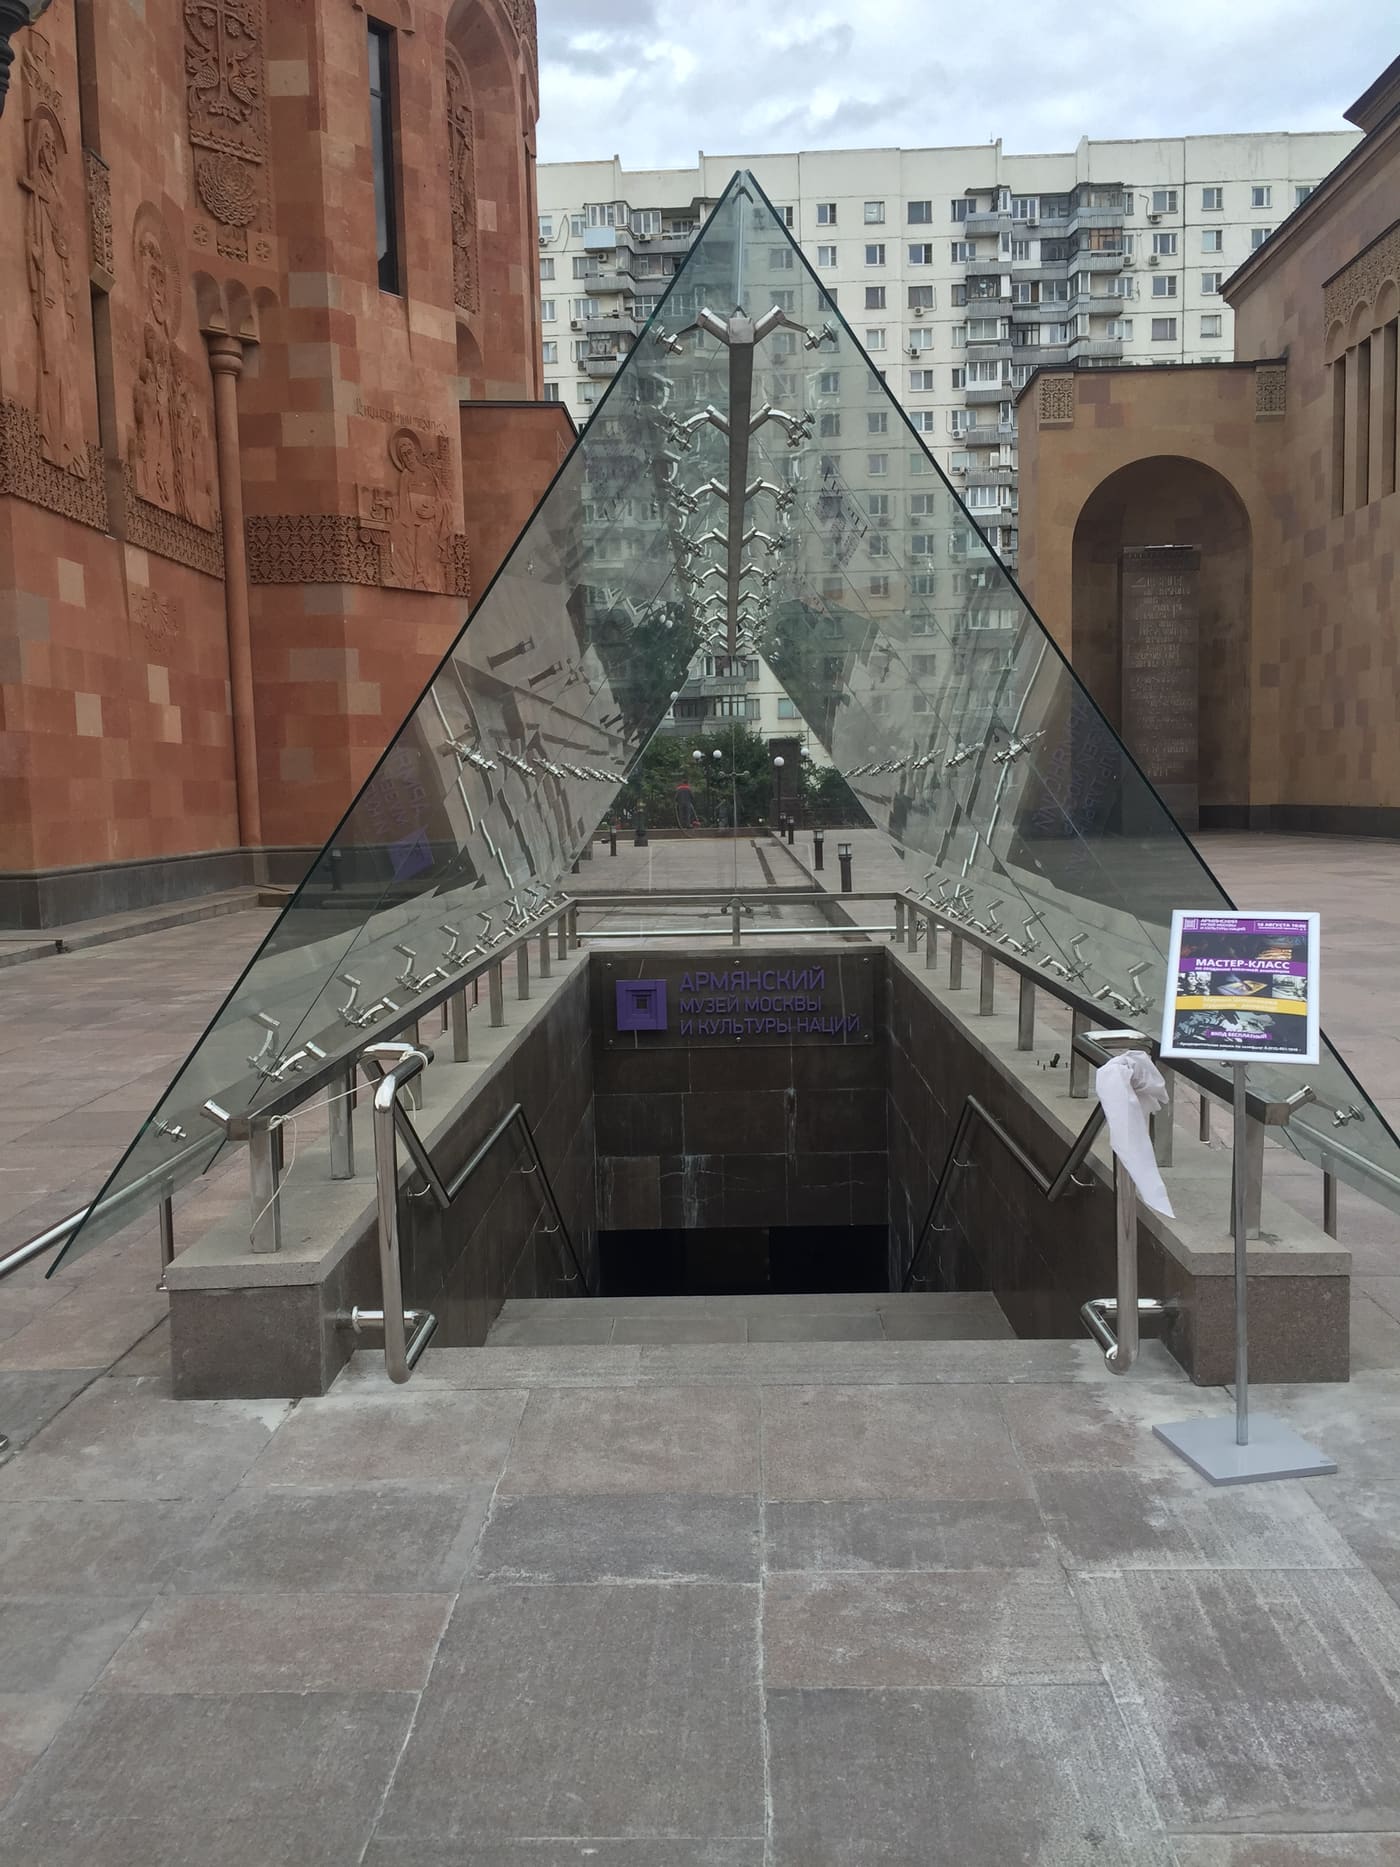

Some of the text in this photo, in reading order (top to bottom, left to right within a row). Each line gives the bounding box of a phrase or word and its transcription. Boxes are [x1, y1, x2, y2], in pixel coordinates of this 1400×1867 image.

[1196, 959, 1290, 969] МАСТЕР-КЛАСС
[679, 965, 825, 992] АРМЯНСКИЙ
[680, 994, 822, 1013] МУЗЕЙ МОСКВЫ
[680, 1013, 861, 1035] И КУЛЬТУРЫ НАЦИЙ
